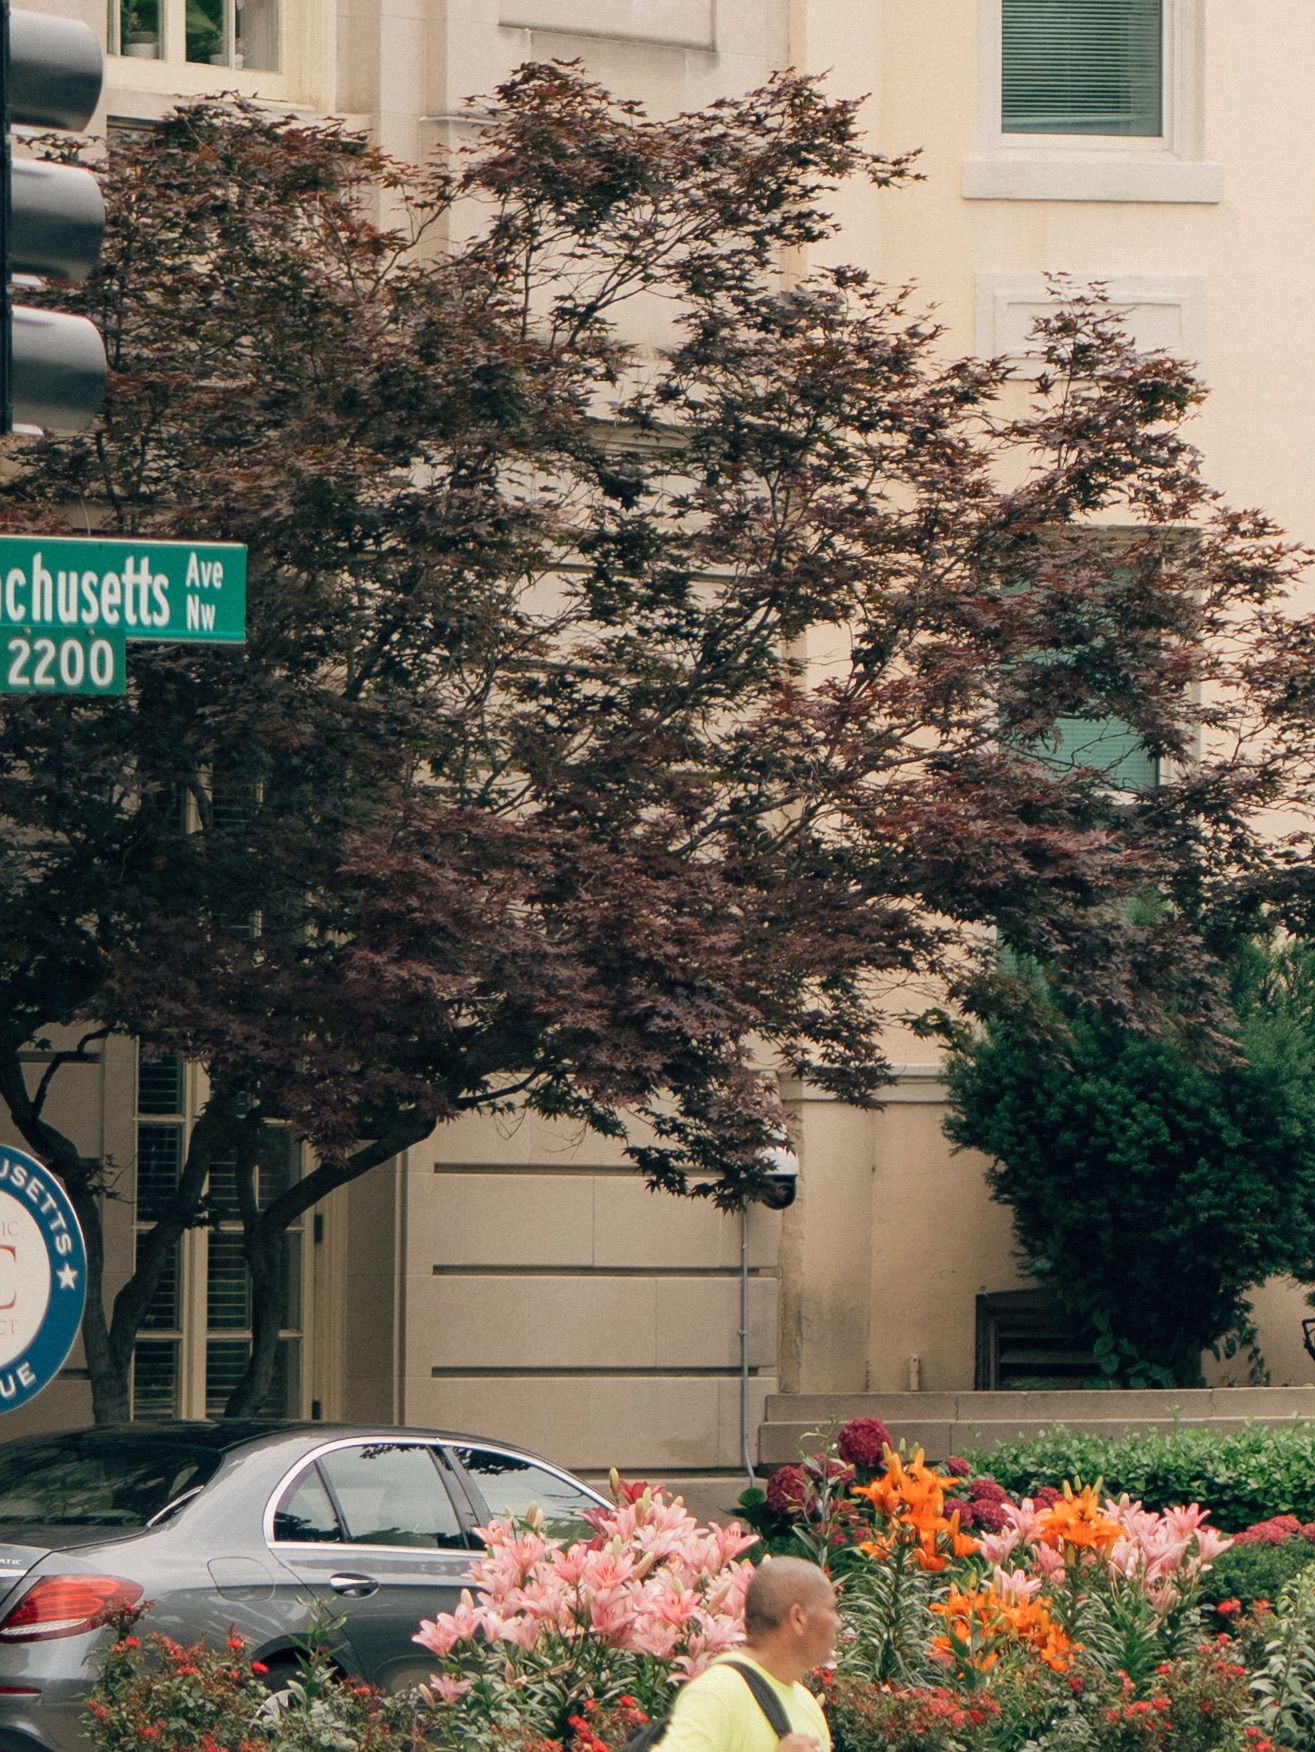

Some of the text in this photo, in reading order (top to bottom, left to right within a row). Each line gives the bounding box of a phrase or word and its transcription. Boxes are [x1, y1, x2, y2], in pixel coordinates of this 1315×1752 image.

[0, 551, 224, 627] chusetts Ave
[186, 593, 216, 632] Nw
[8, 638, 114, 687] 2200
